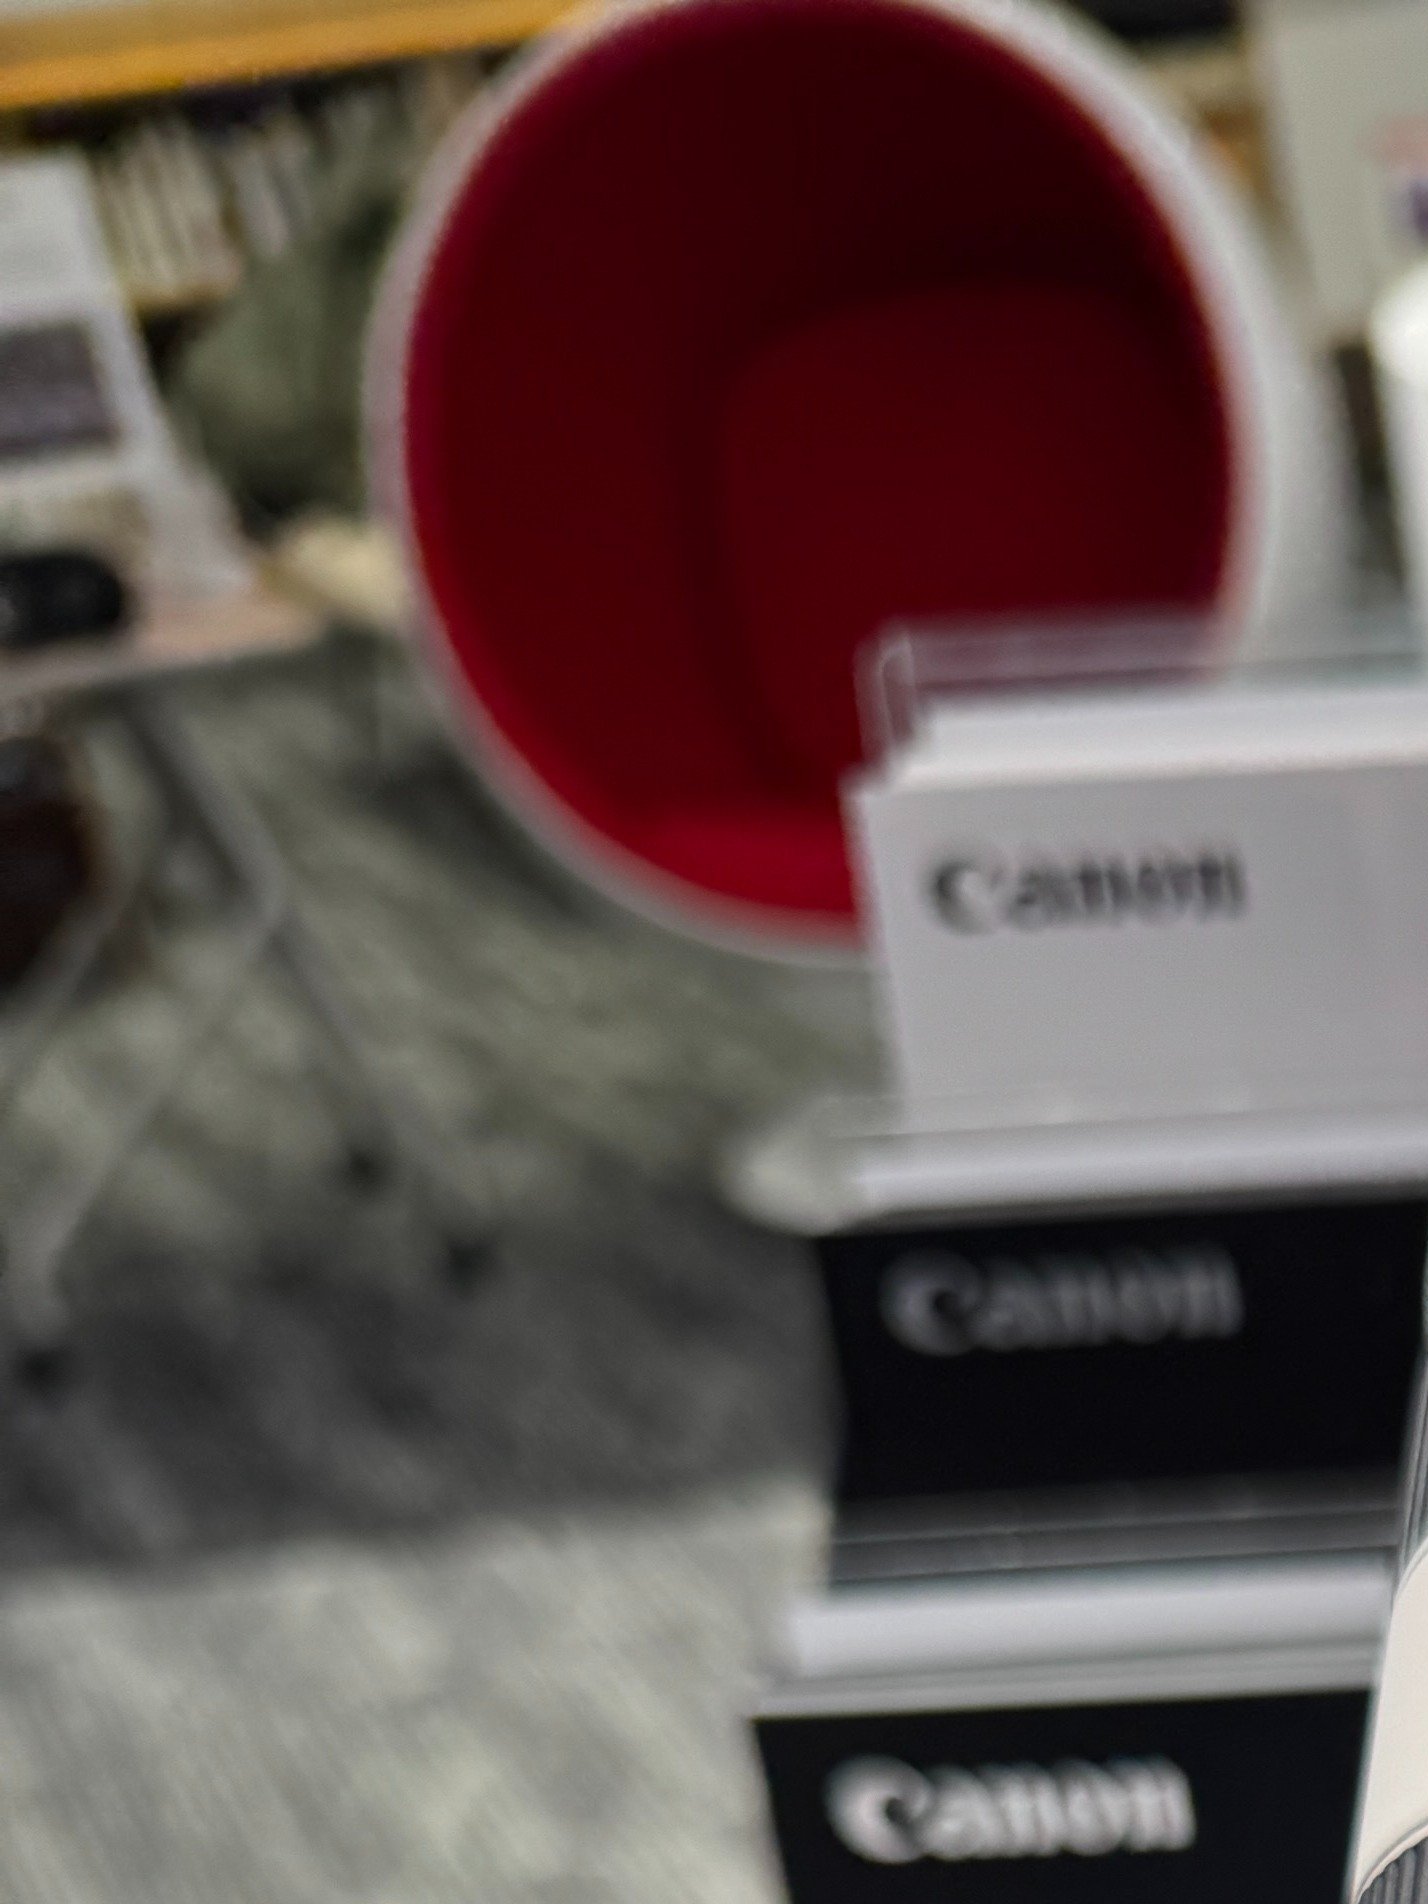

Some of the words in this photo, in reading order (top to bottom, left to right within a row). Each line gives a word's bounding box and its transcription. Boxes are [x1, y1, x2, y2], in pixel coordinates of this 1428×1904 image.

[930, 844, 1250, 934] Canon
[881, 1250, 1244, 1356] Canon
[827, 1755, 1196, 1864] Canon
